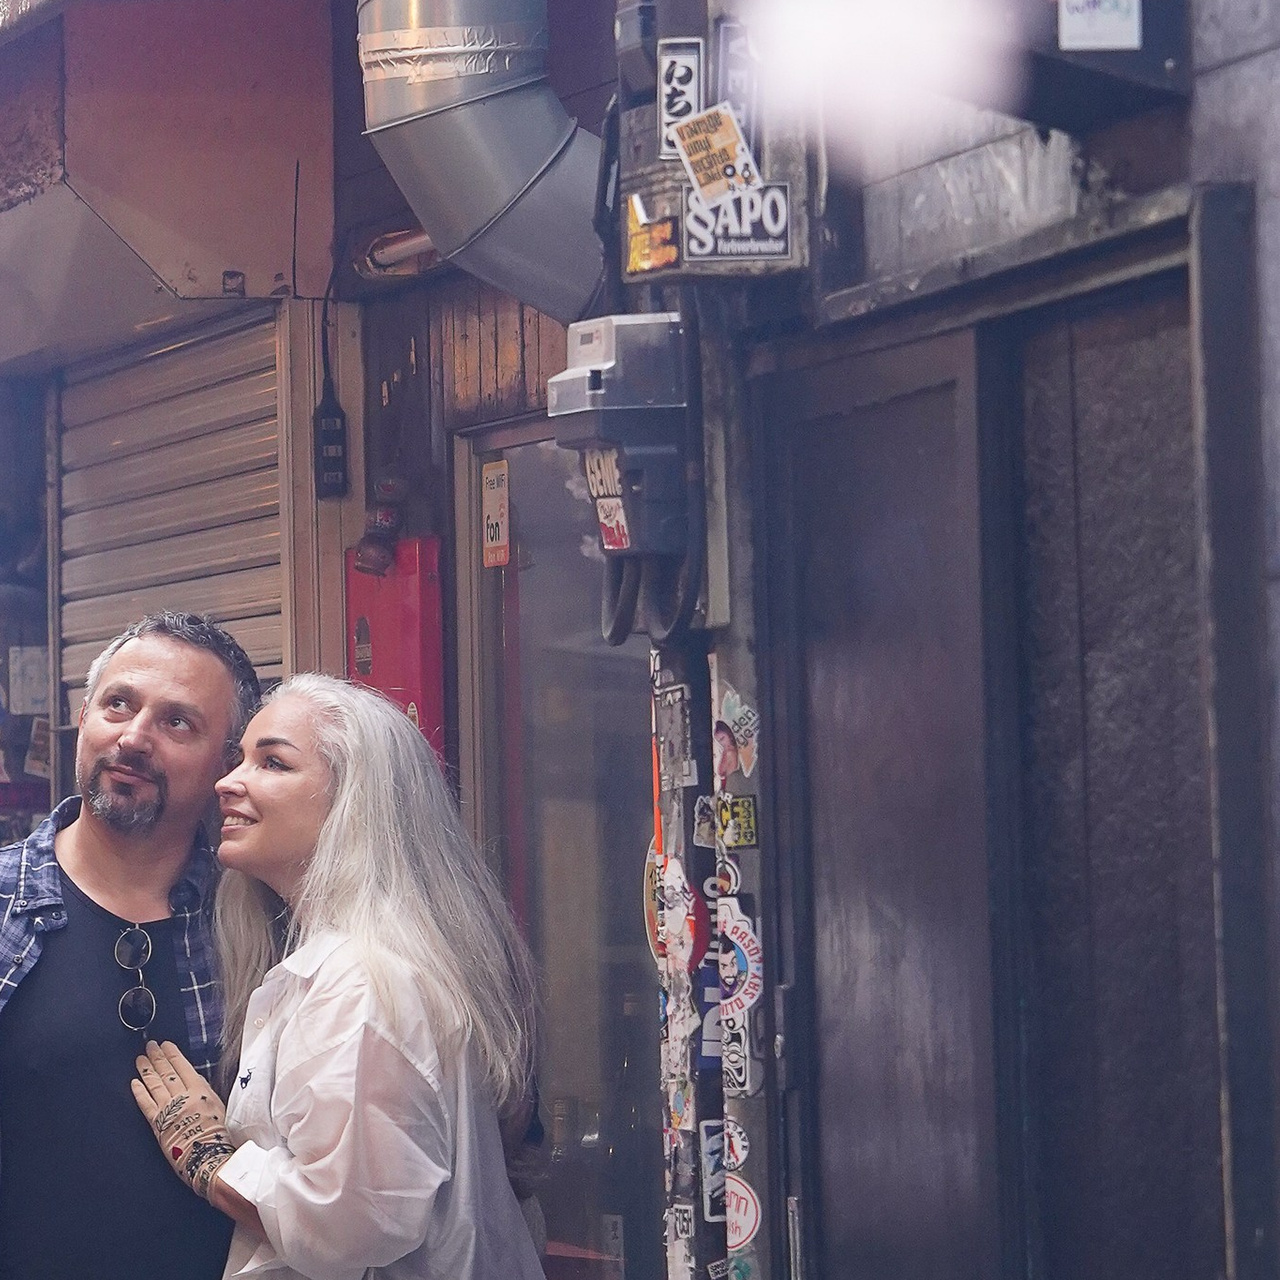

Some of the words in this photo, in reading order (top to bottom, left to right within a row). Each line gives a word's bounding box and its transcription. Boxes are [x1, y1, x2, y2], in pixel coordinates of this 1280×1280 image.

[486, 514, 500, 543] fon
[173, 1112, 201, 1132] cute
[181, 1124, 205, 1141] but
